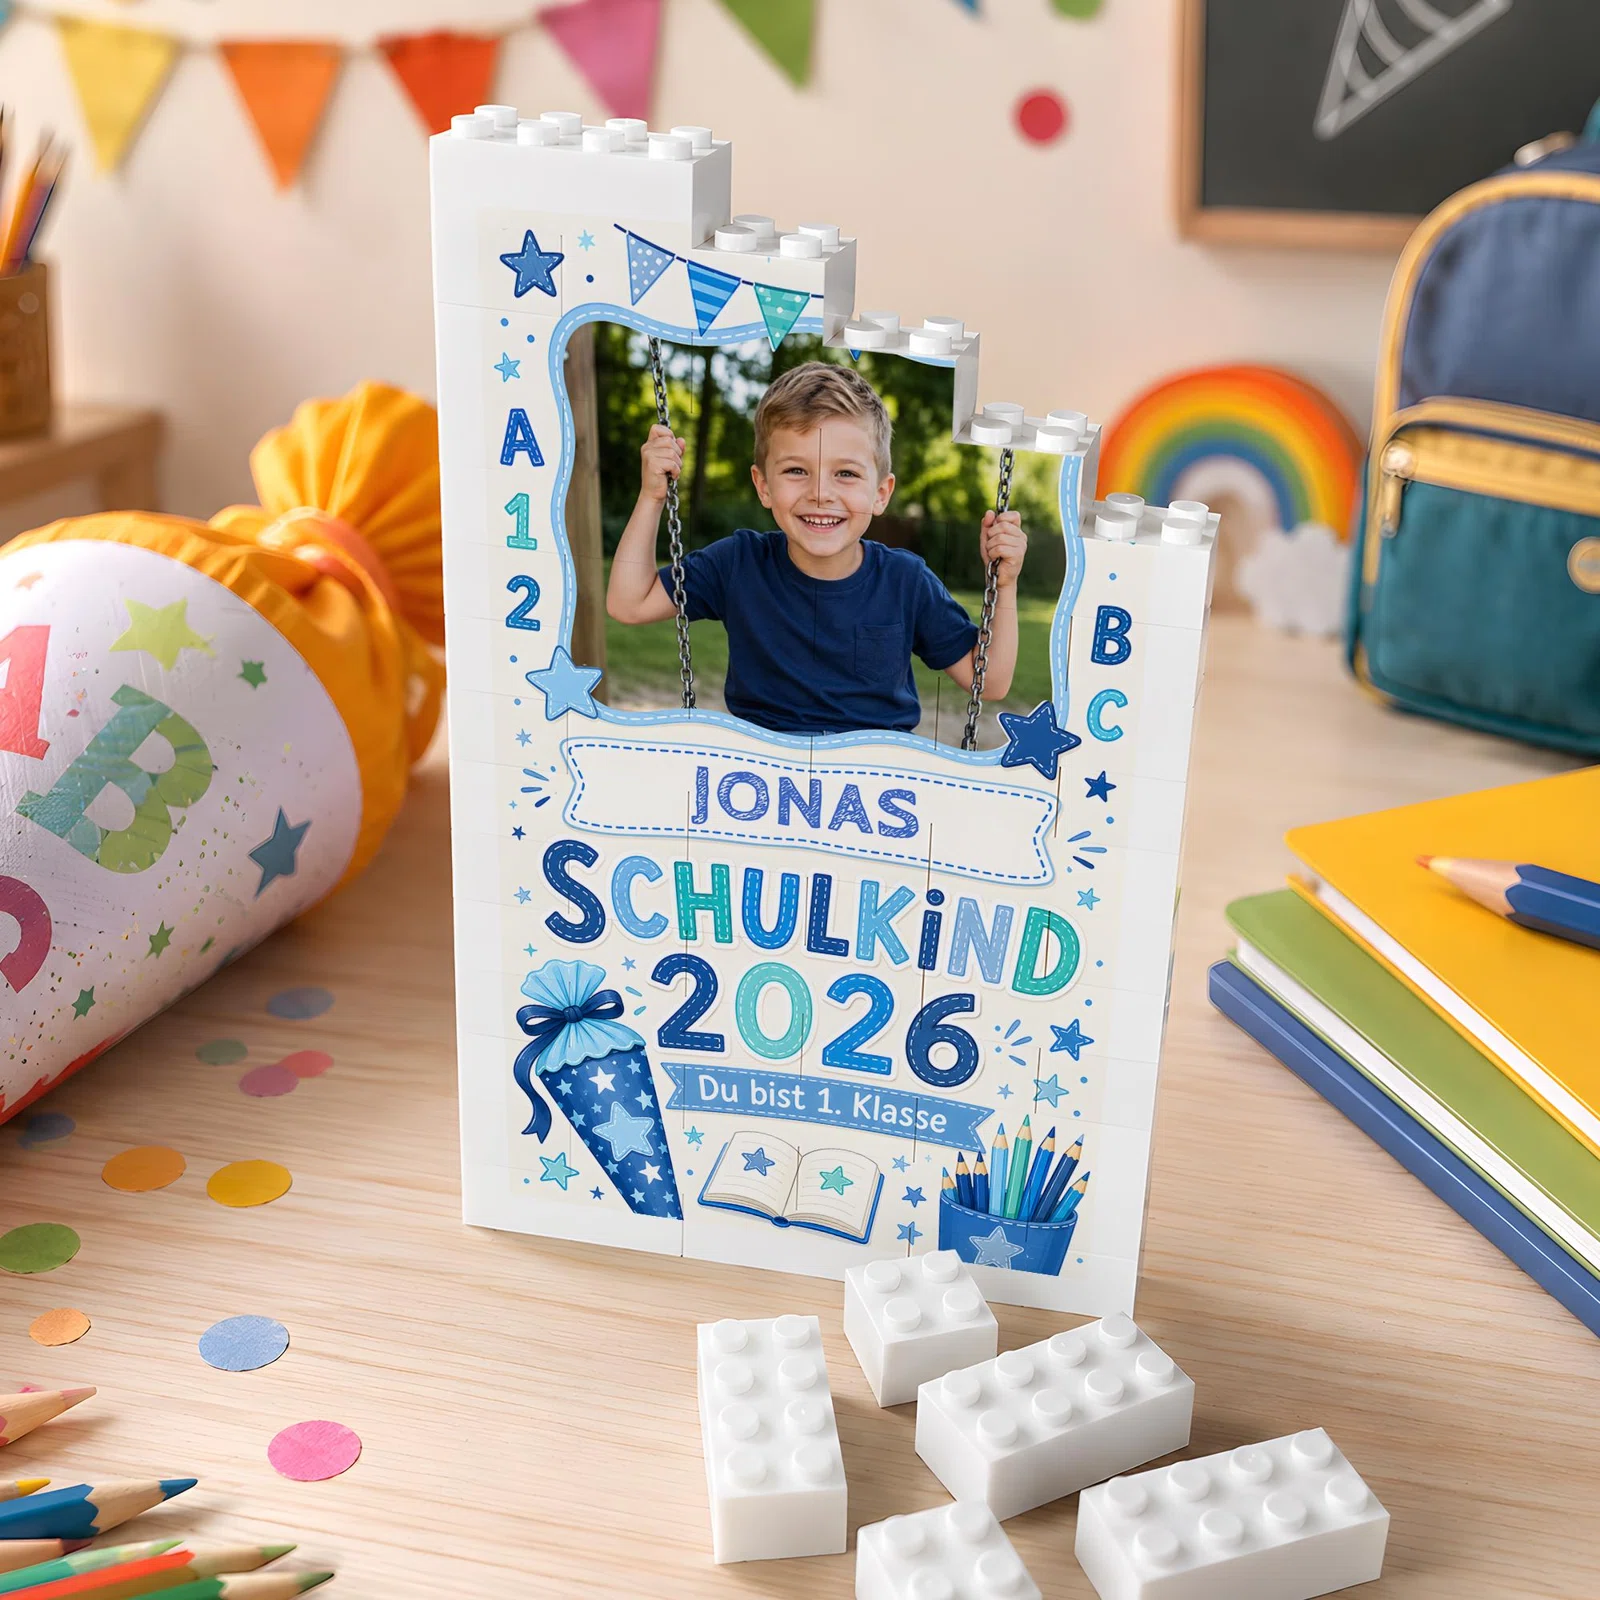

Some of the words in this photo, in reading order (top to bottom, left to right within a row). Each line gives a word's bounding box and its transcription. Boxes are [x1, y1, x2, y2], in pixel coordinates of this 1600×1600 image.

[499, 407, 545, 468] A
[504, 492, 538, 551] 1
[505, 574, 541, 632] 2
[1090, 605, 1132, 666] B
[1086, 688, 1129, 743] C
[15, 683, 213, 874] B
[691, 765, 920, 840] JONAS
[650, 952, 981, 1088] 2026
[698, 1073, 739, 1103] Du
[750, 1078, 806, 1110] bist
[817, 1086, 842, 1116] 1.
[852, 1091, 948, 1134] Klasse
